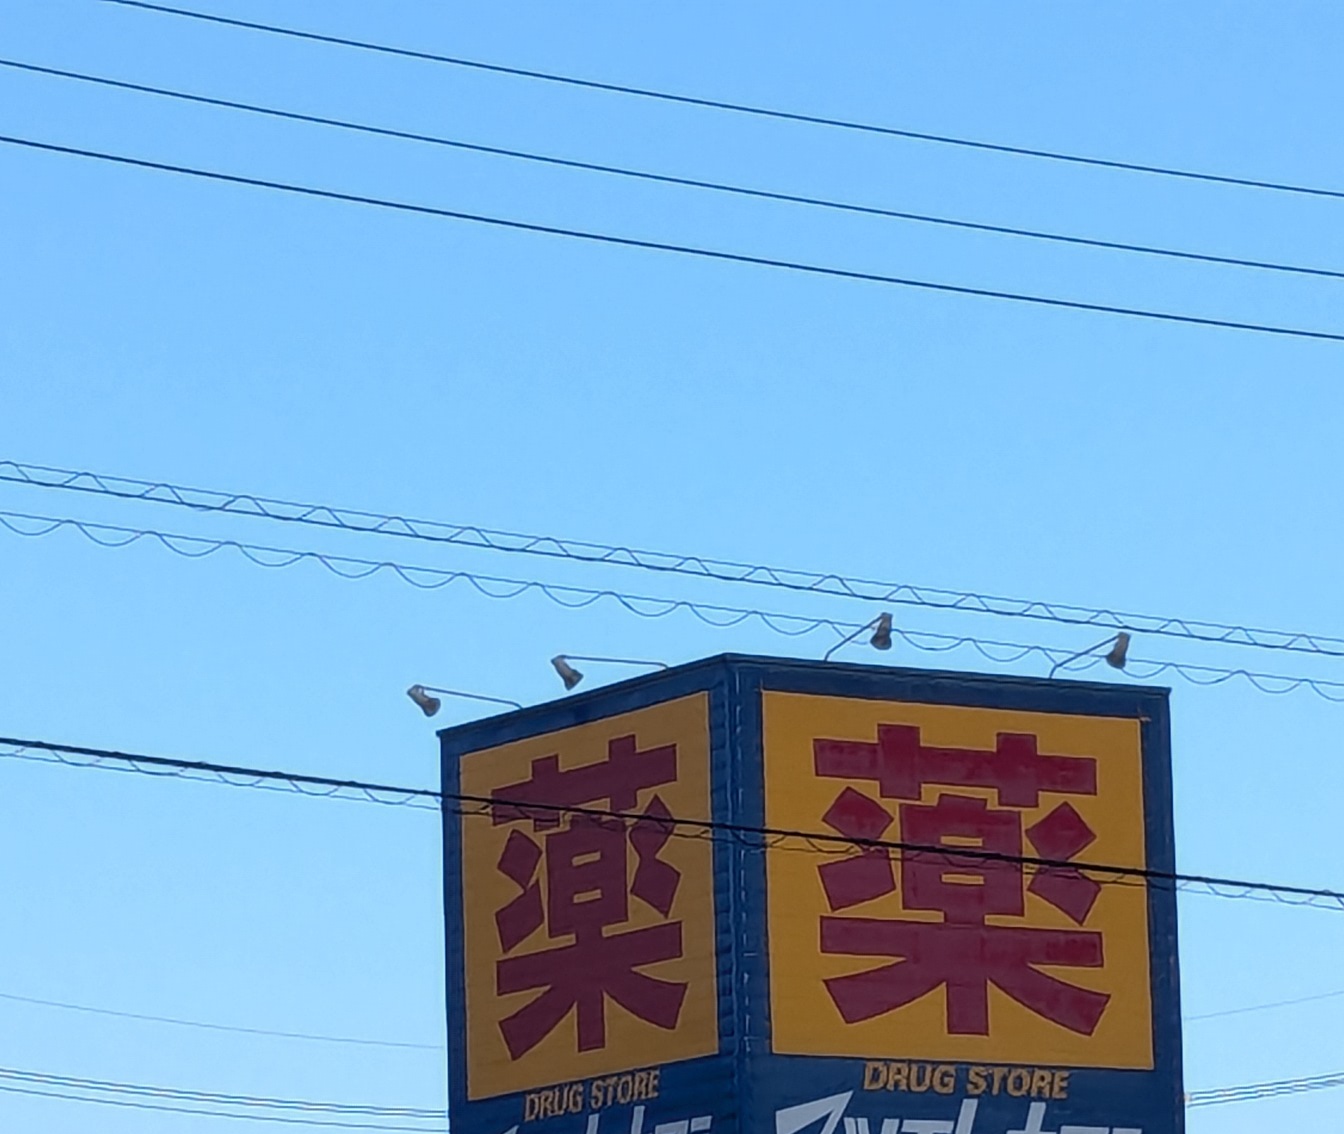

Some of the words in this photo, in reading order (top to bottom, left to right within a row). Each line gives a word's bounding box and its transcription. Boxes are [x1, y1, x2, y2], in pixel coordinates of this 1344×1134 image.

[492, 734, 688, 1060] 薬
[813, 724, 1110, 1036] 薬
[524, 1083, 583, 1122] DRUG
[591, 1069, 660, 1108] STORE
[863, 1060, 955, 1095] DRUG
[966, 1065, 1070, 1099] STORE
